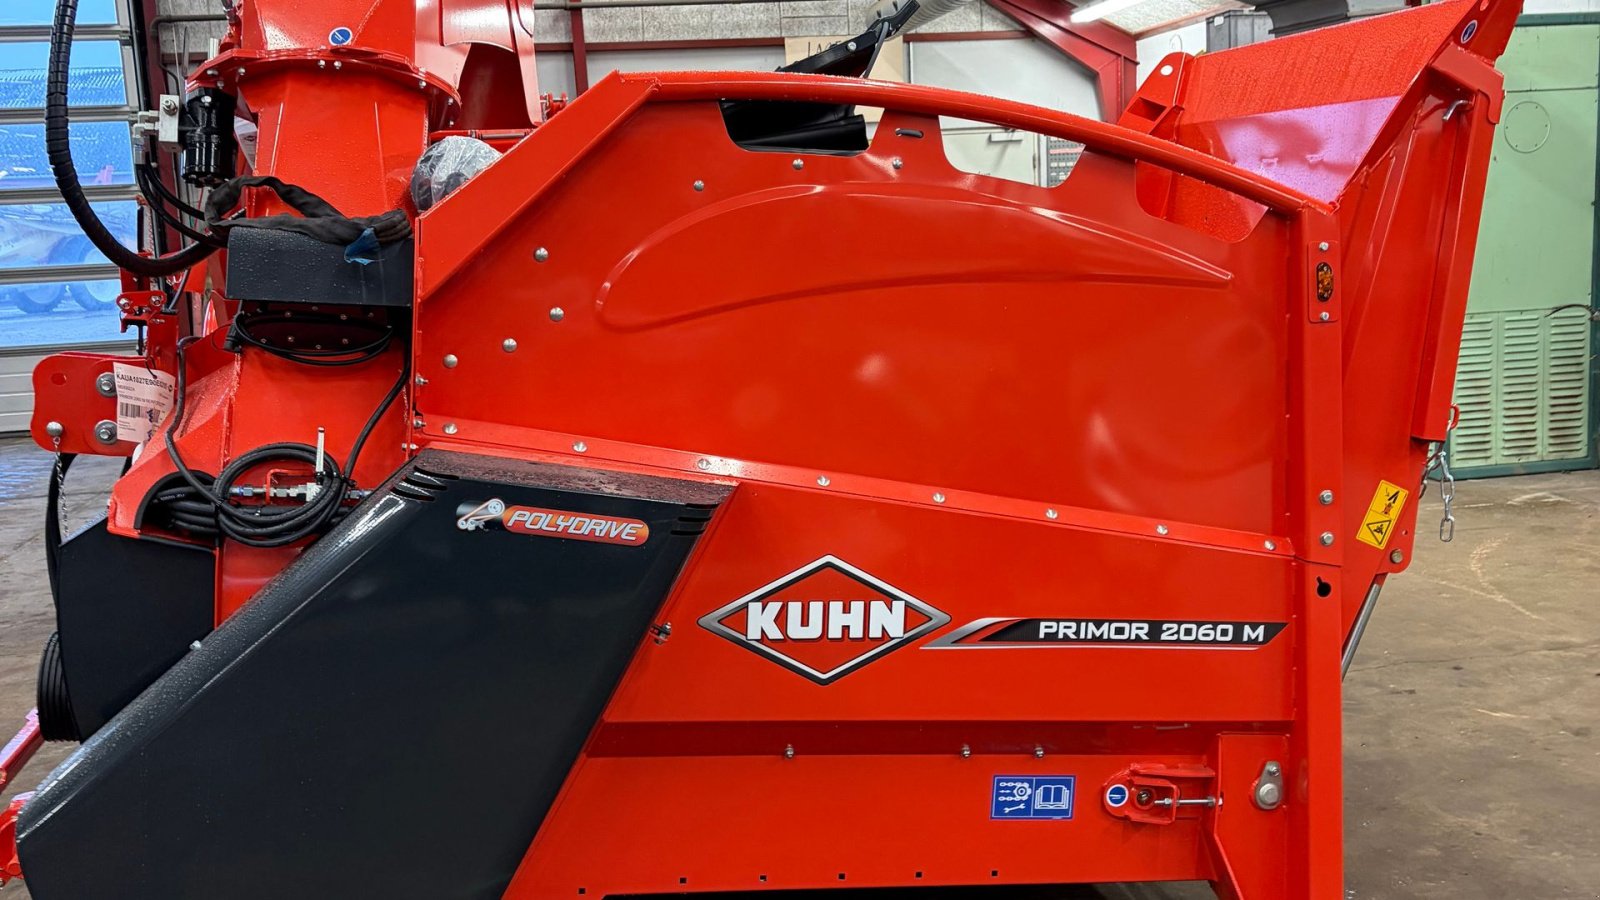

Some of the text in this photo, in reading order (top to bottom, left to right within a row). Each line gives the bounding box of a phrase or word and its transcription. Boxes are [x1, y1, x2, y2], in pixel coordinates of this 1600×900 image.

[507, 511, 644, 541] POLYDRIVE
[746, 600, 906, 640] KUHN
[1039, 621, 1265, 642] PRIMOR 2060 M
